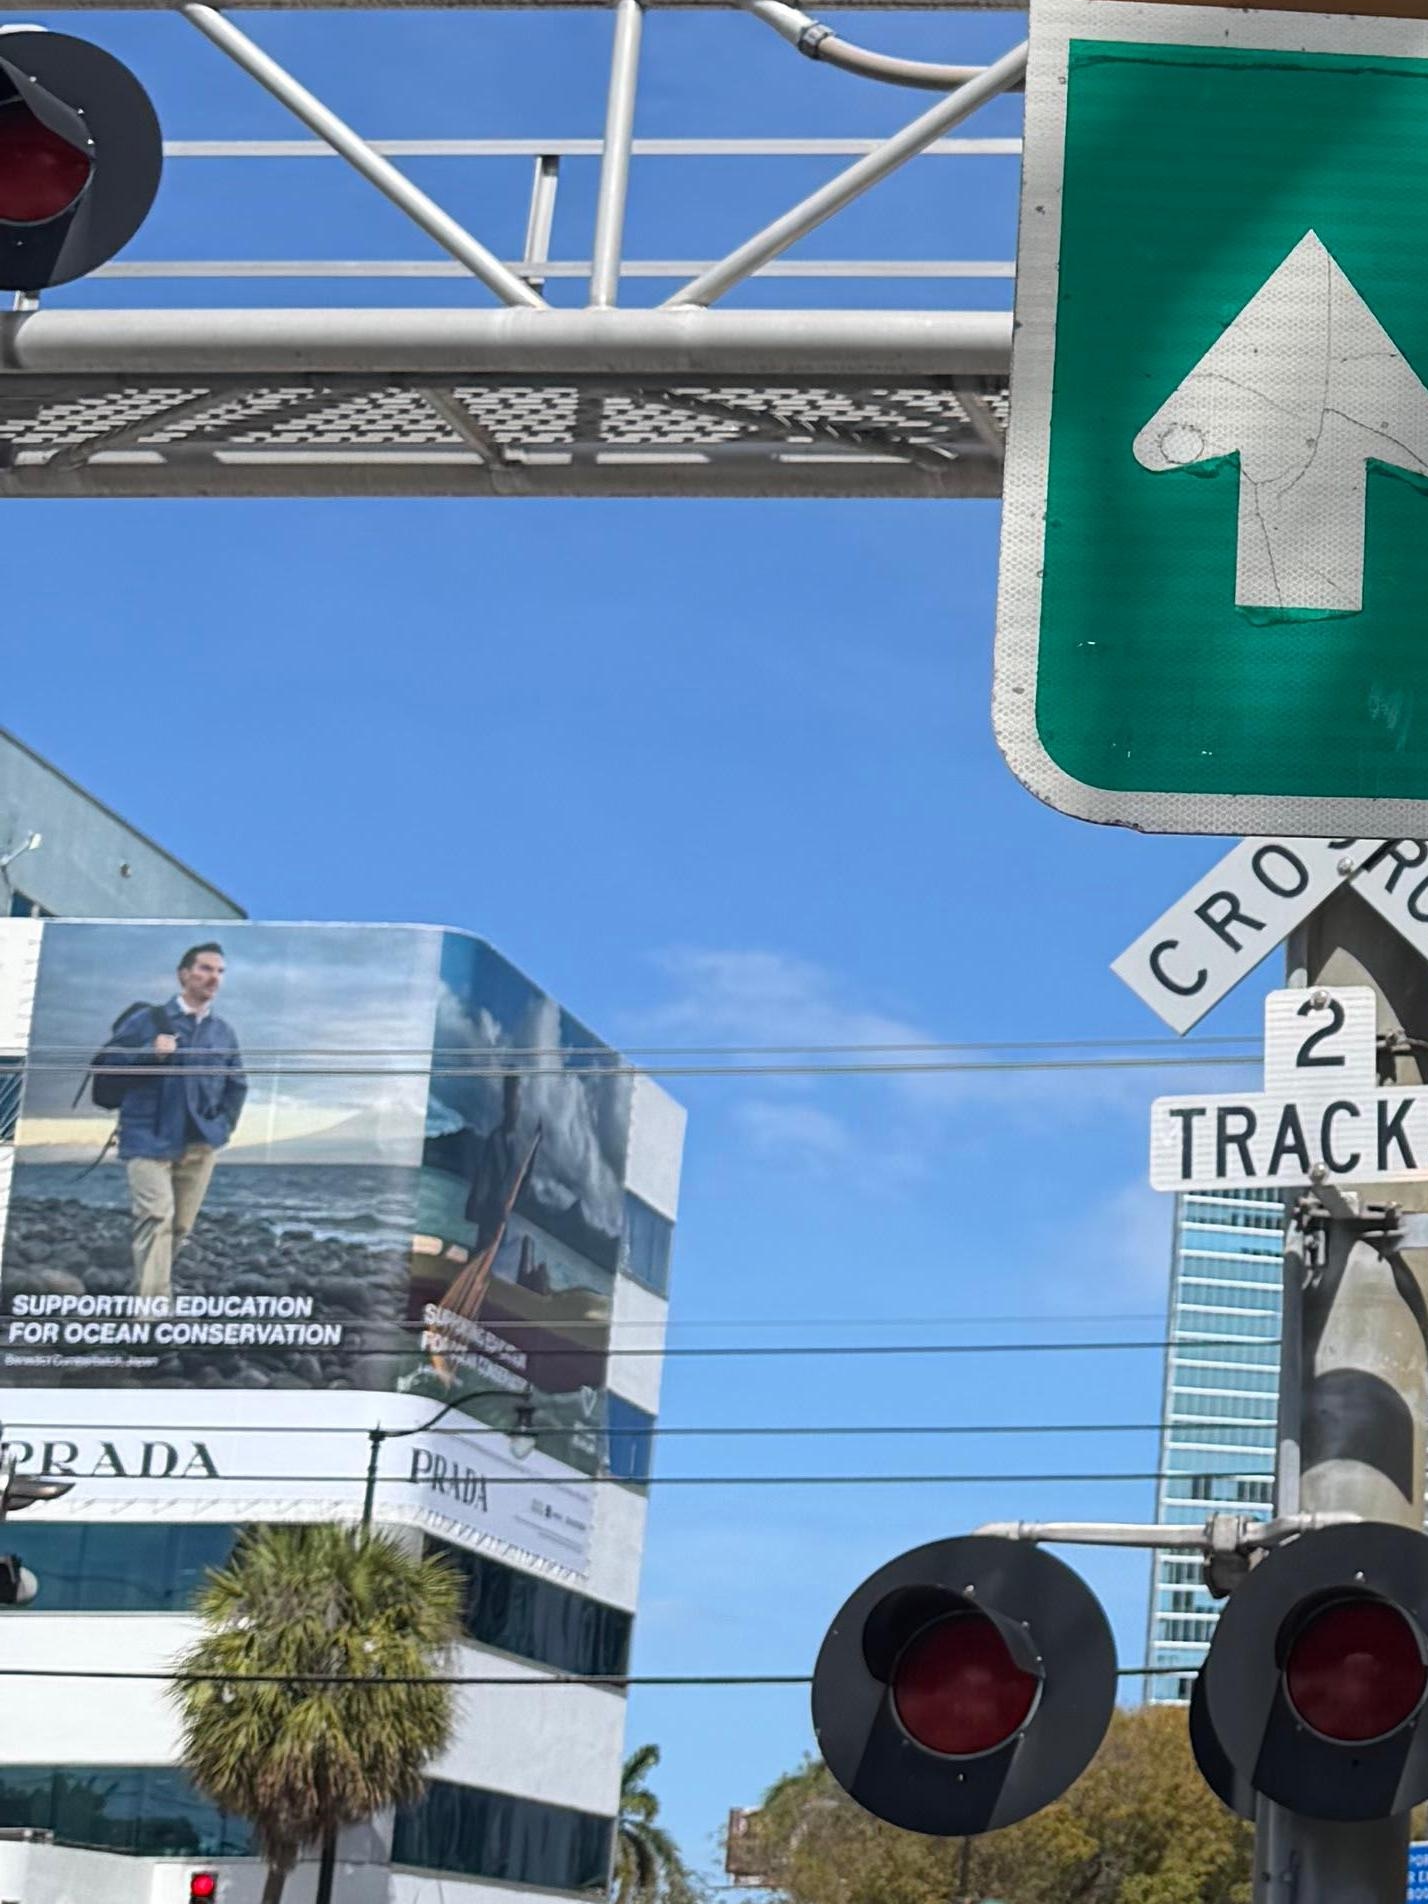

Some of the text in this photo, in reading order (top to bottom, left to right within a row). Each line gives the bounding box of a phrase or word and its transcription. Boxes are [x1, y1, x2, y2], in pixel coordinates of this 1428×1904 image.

[1149, 838, 1356, 997] CRO
[1296, 997, 1346, 1068] 2
[11, 1293, 314, 1319] SUPPORTING EDUCATION
[8, 1321, 343, 1346] FOR OCEAN CONSERVATION
[8, 1440, 220, 1479] PRADA
[410, 1447, 489, 1513] PRADA
